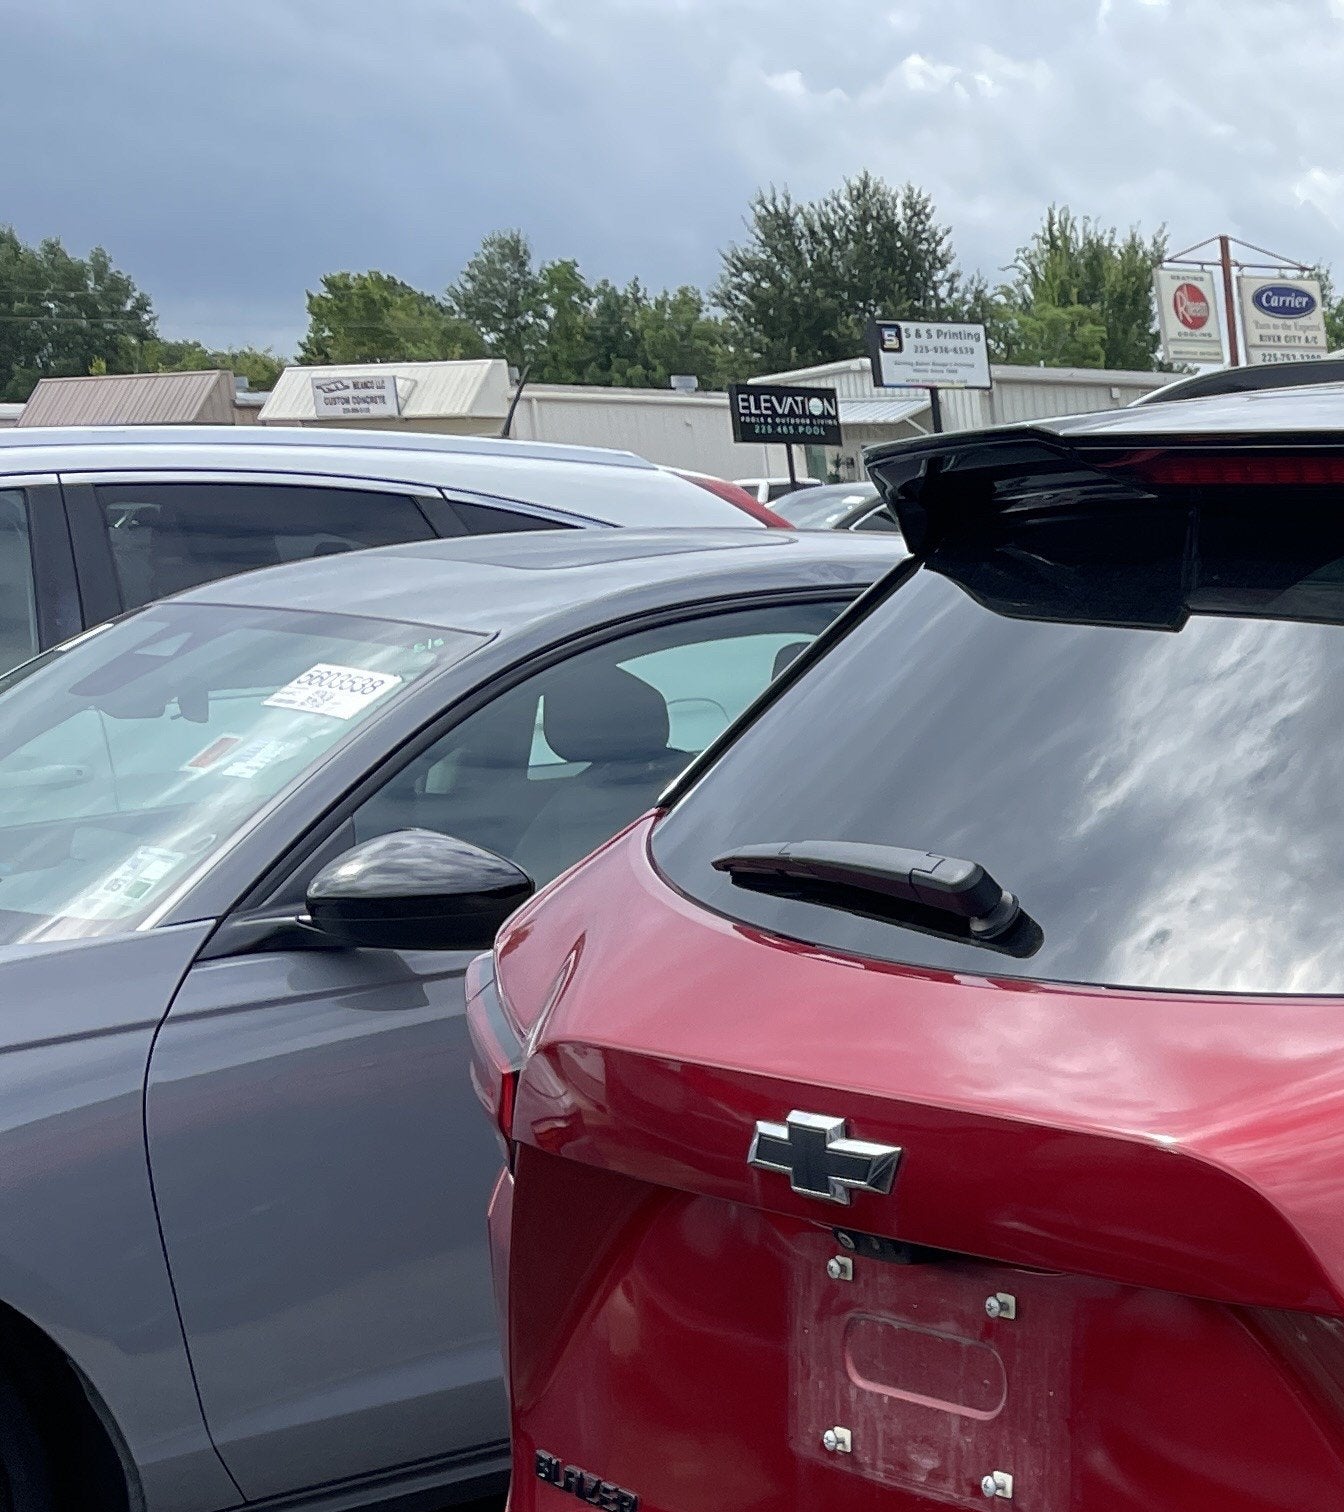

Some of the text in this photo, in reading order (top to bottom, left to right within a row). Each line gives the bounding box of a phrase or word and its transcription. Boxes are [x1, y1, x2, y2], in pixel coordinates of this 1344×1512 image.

[1261, 291, 1309, 308] Carrier
[904, 328, 981, 343] S & S Printing
[323, 395, 387, 406] CUSTOM CONCRETE
[738, 394, 836, 416] ELEVATION
